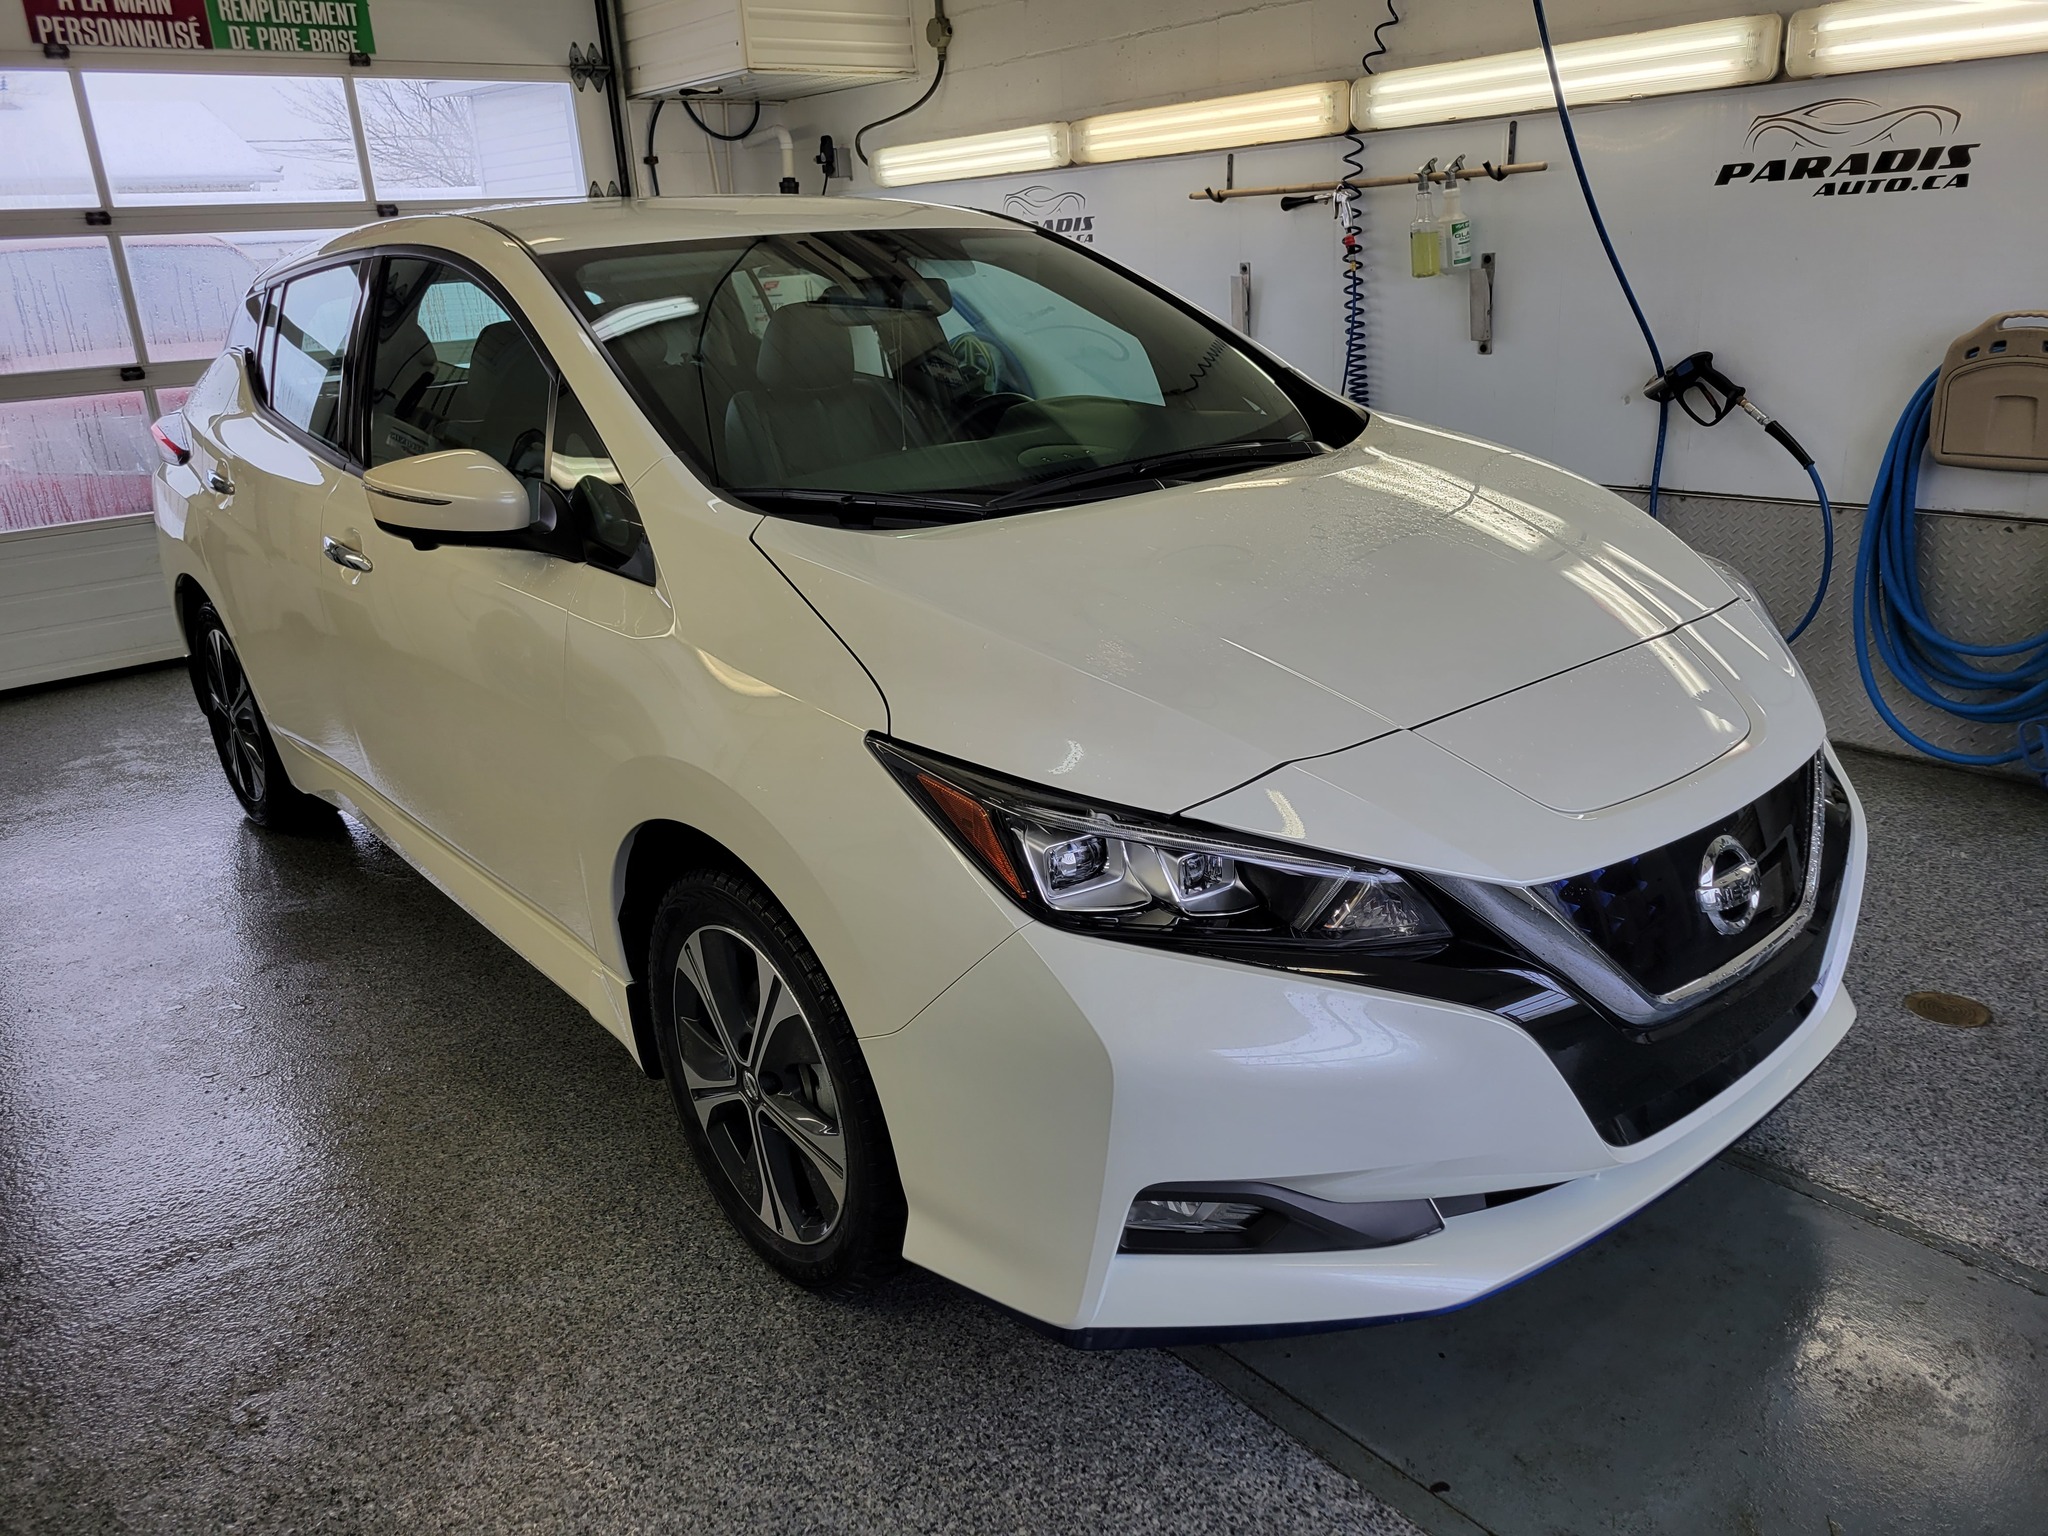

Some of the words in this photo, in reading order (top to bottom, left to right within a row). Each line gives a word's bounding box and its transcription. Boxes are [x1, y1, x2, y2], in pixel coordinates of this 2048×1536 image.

[112, 0, 173, 15] MAIN
[217, 0, 358, 26] REMPLACEMENT
[35, 15, 205, 49] PERSONNALISÉ
[228, 25, 252, 50] DE
[256, 27, 361, 53] PARE-BRISE
[1714, 143, 1981, 186] PARADIS
[1812, 173, 1970, 197] AUTO.CA
[1030, 216, 1095, 232] ADIS
